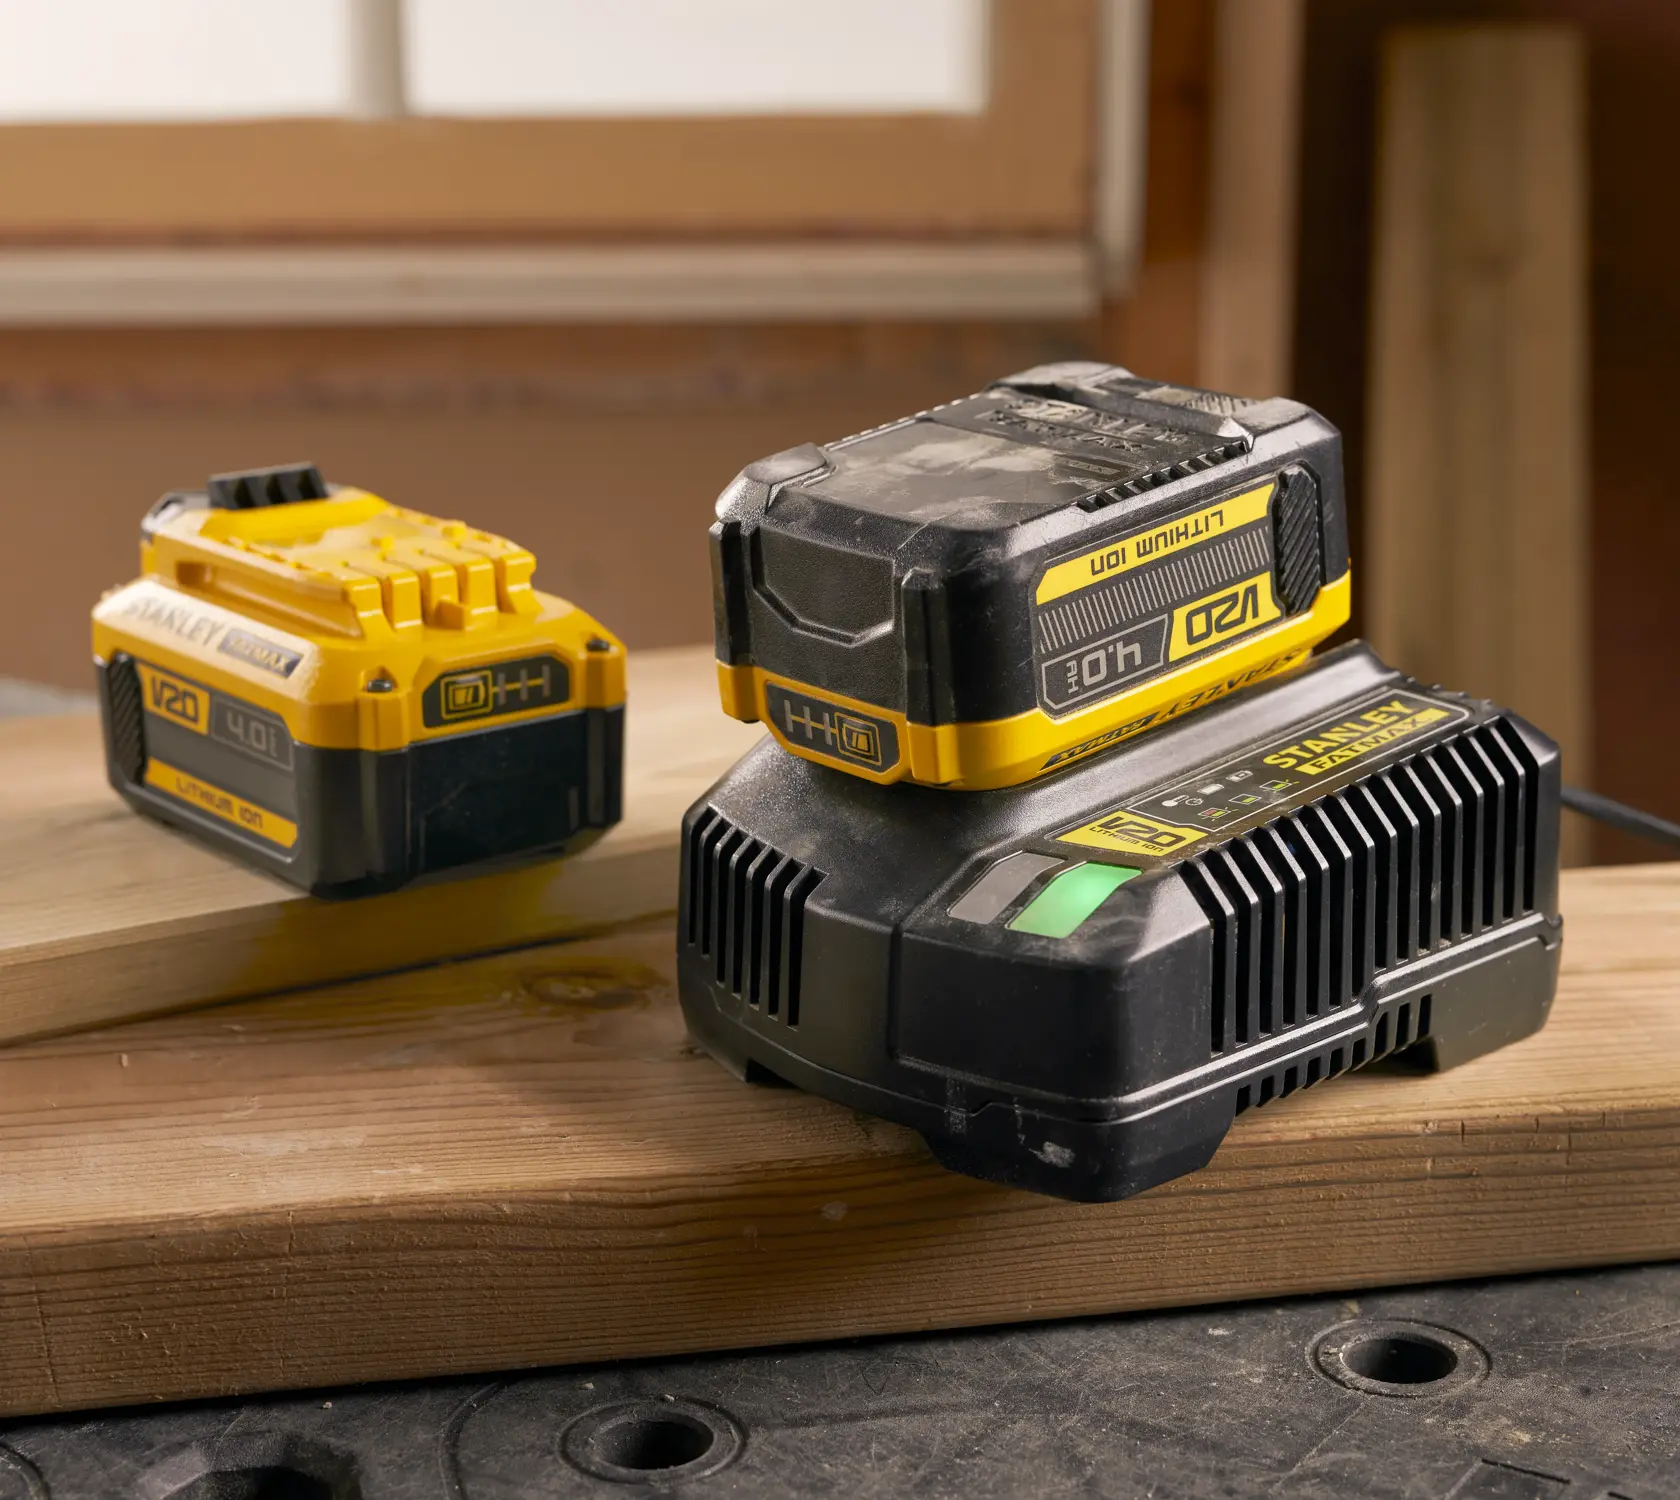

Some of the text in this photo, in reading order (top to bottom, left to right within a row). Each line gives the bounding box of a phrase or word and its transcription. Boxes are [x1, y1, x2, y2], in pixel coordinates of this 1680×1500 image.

[1090, 509, 1224, 576] LITHIUM ION
[1186, 583, 1260, 646] V20
[1081, 641, 1142, 687] 4.0
[151, 676, 200, 725] V20
[1263, 700, 1413, 769] STANLEY
[1310, 718, 1429, 770] FATMAX
[1089, 826, 1165, 853] LITHIUM ION
[1096, 816, 1188, 848] V20
